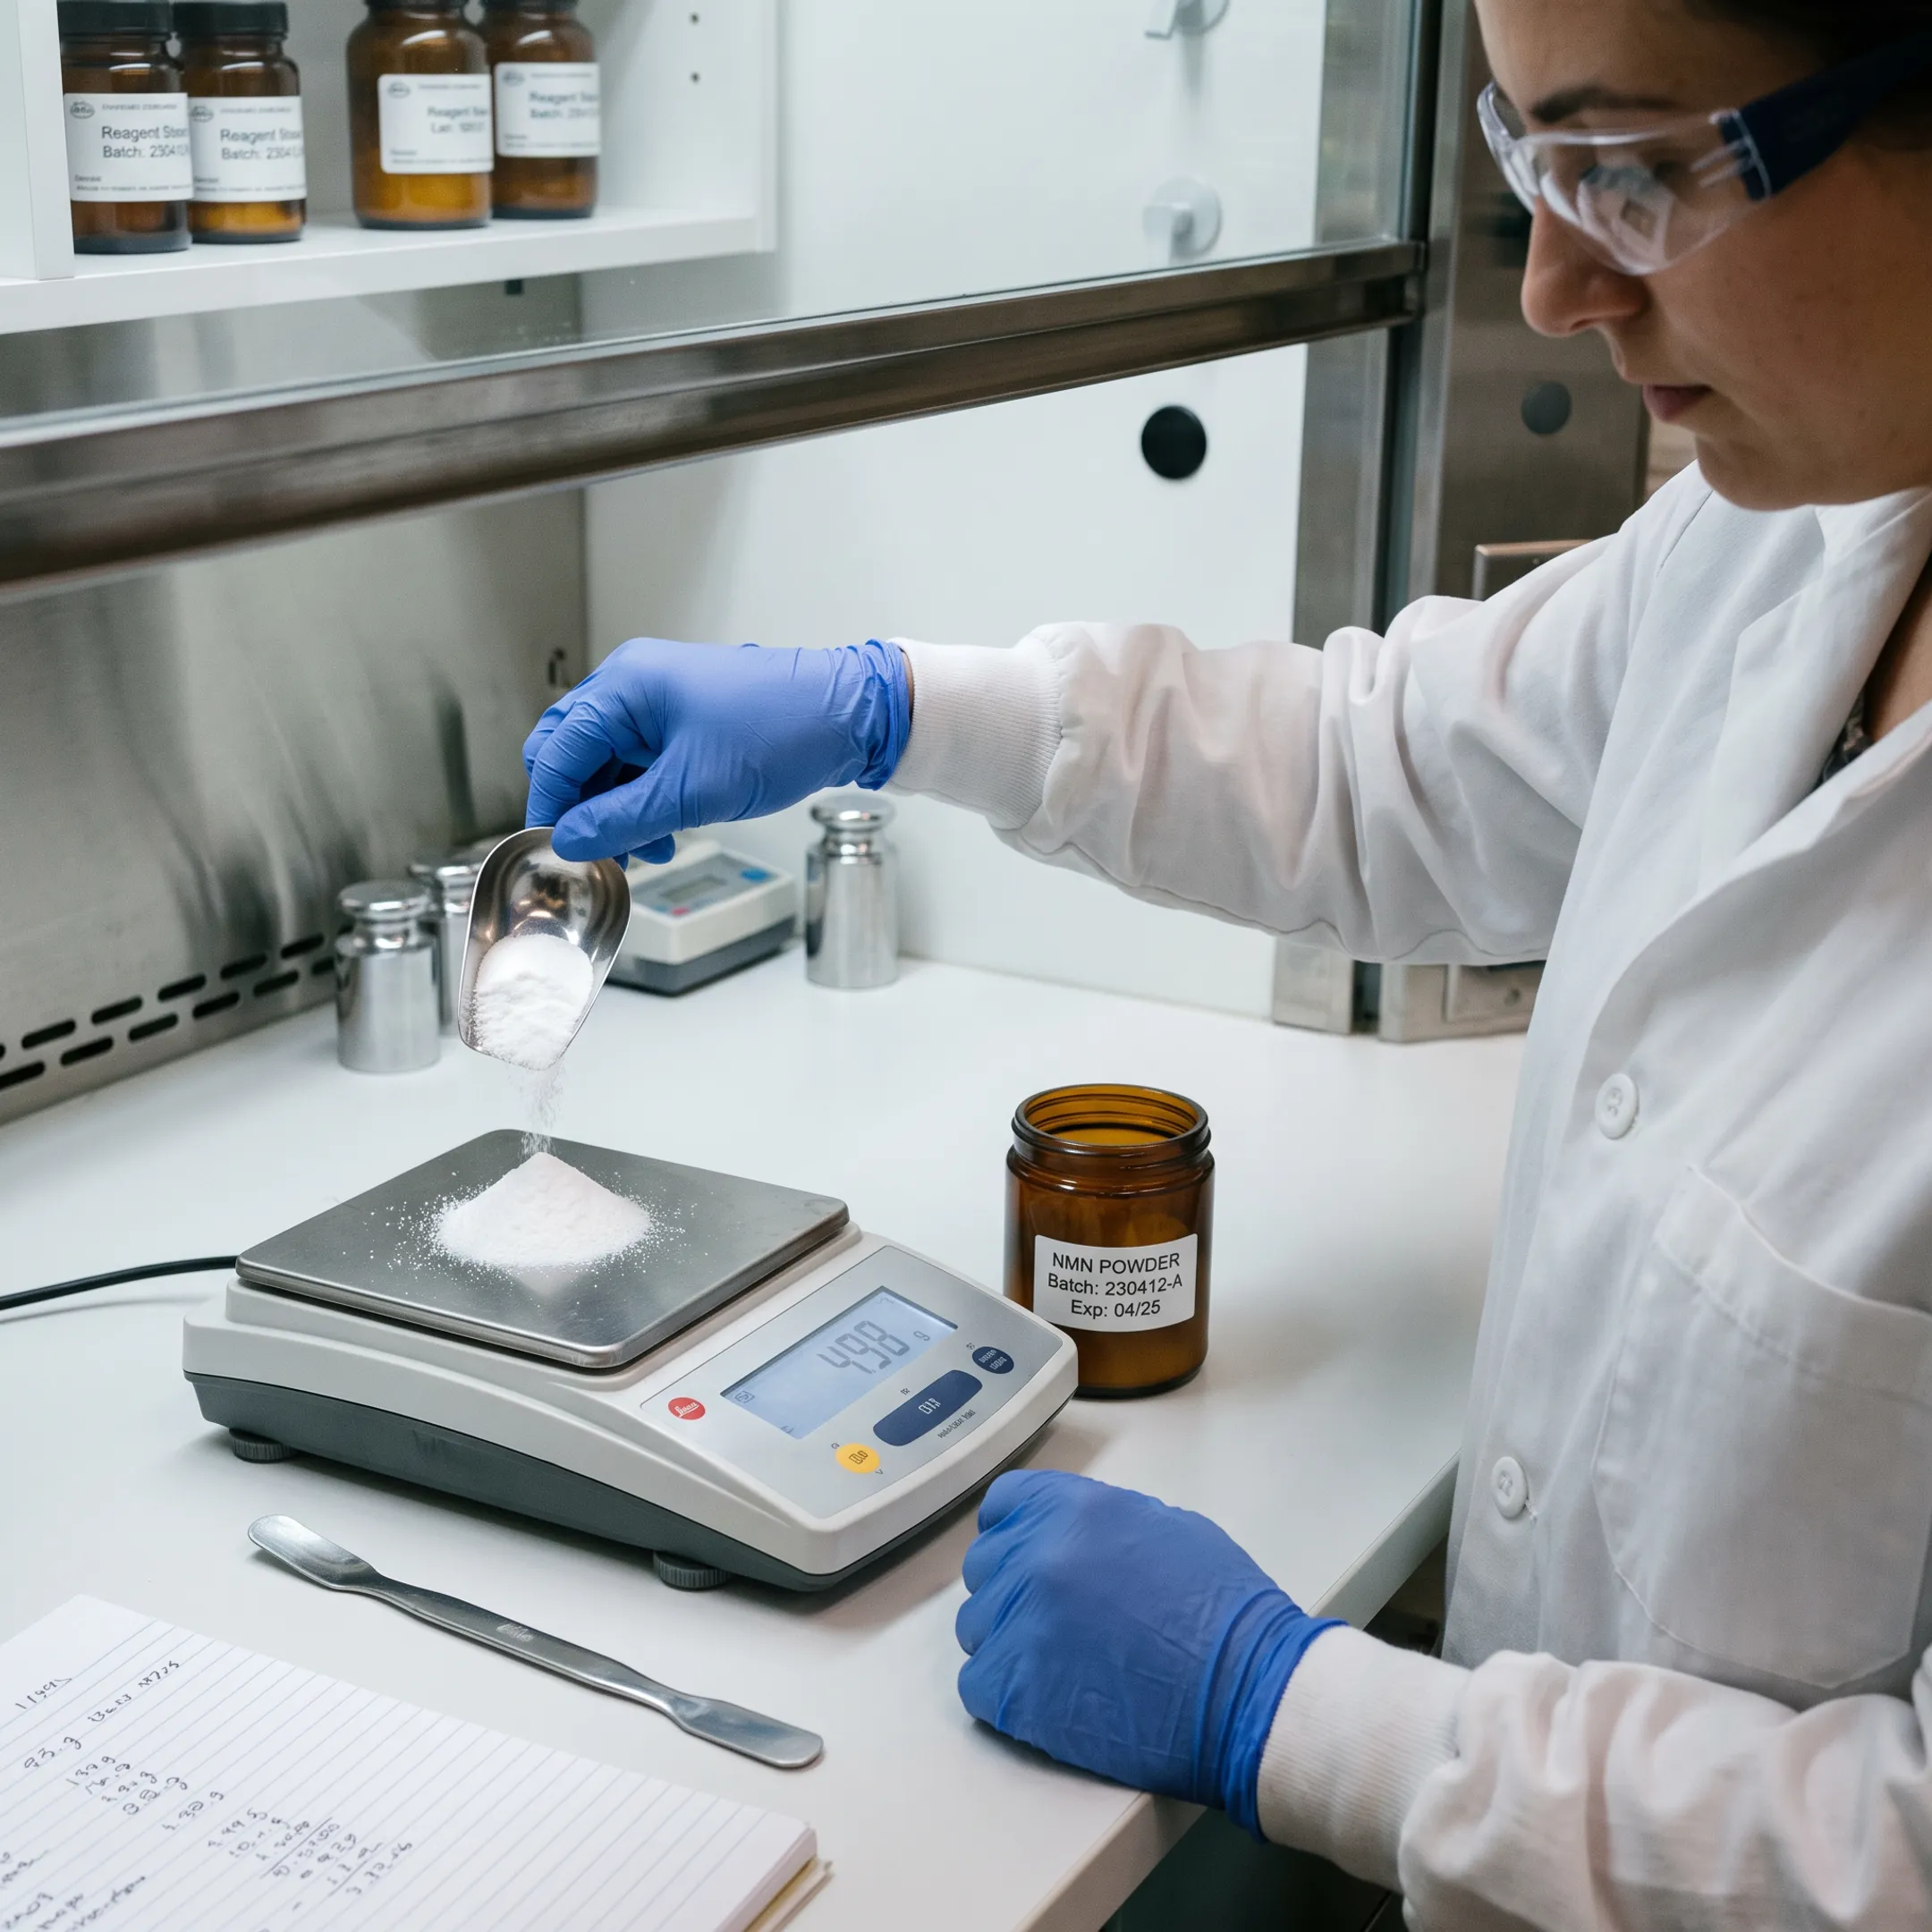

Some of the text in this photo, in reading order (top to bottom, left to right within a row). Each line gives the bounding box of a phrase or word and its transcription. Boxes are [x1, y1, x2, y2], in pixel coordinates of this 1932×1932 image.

[101, 126, 160, 143] Reagent
[220, 128, 276, 145] Reagent
[103, 145, 146, 158] Batch:
[222, 148, 261, 160] Batch:
[1052, 1252, 1180, 1275] NMN POWDER
[1048, 1273, 1182, 1296] Batch: 230412-A
[1071, 1300, 1161, 1319] Exp: 04/25
